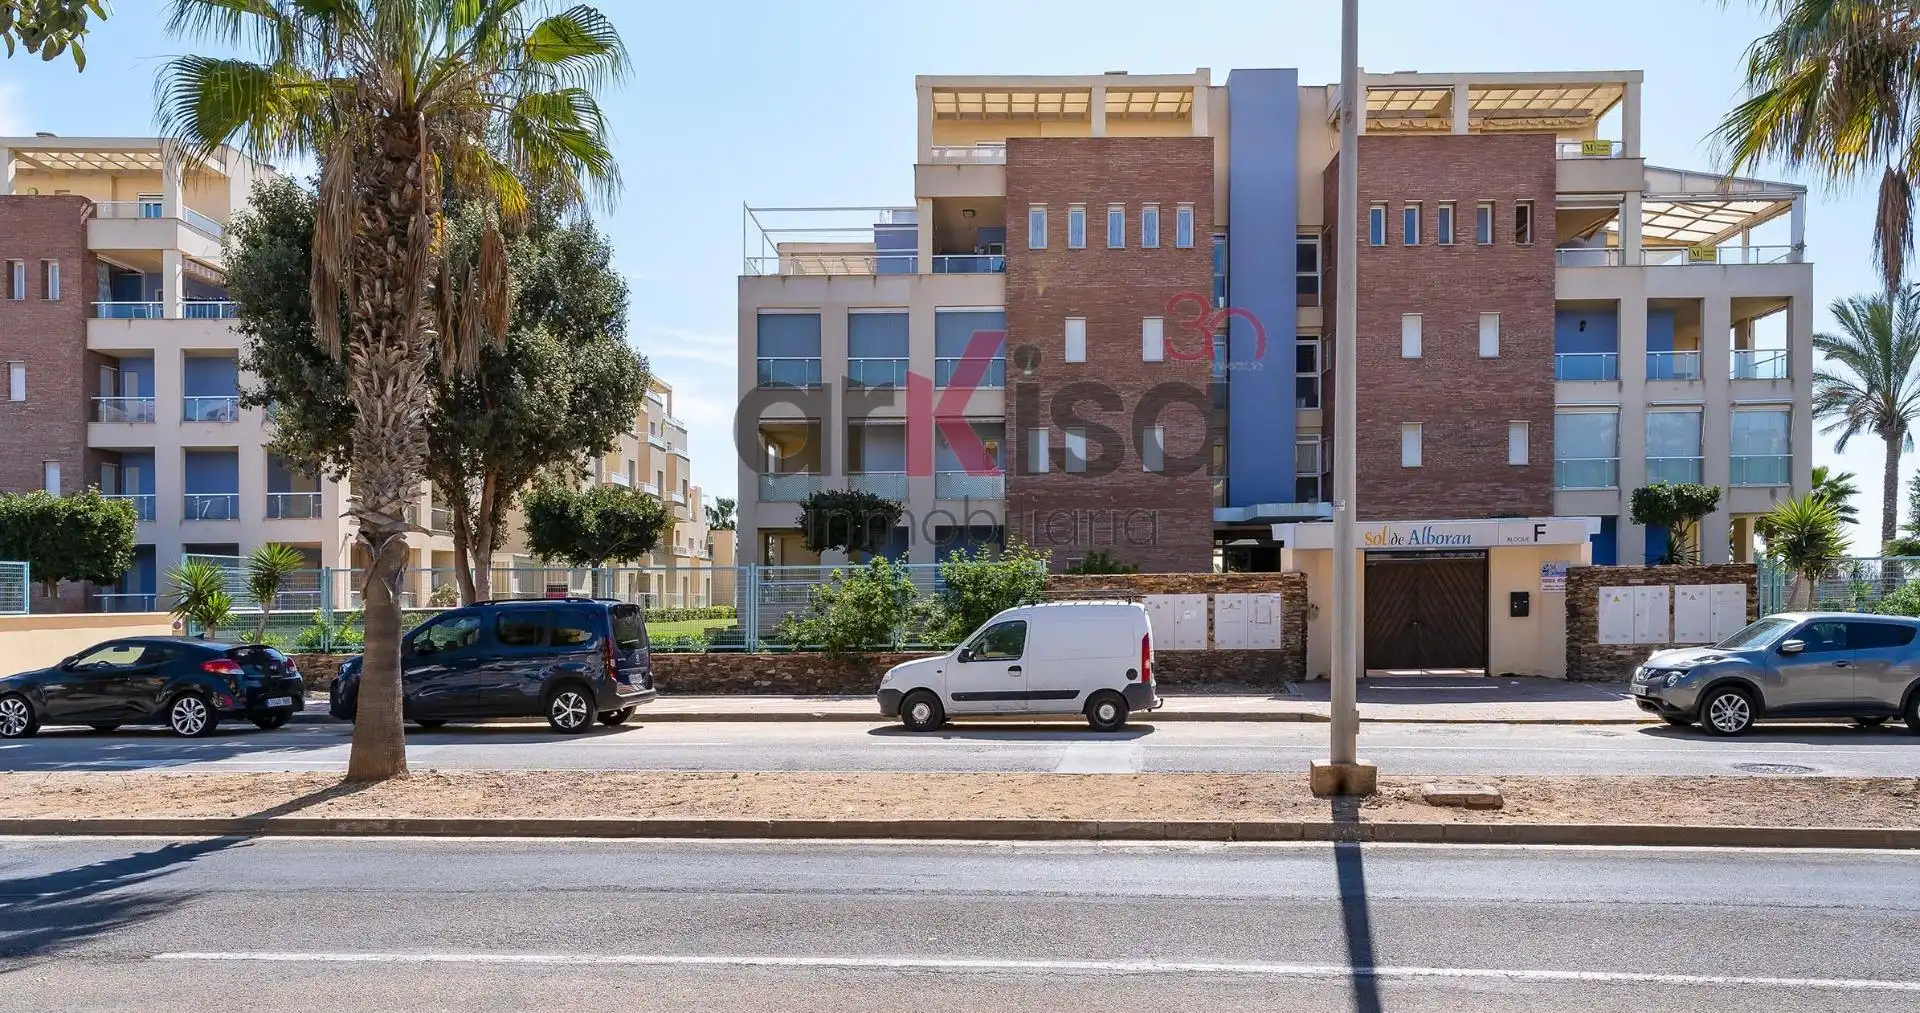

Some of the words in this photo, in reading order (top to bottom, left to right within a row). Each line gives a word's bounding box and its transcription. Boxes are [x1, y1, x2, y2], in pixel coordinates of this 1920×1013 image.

[1390, 532, 1405, 546] de
[1408, 525, 1472, 546] Alboran
[1534, 523, 1547, 542] F
